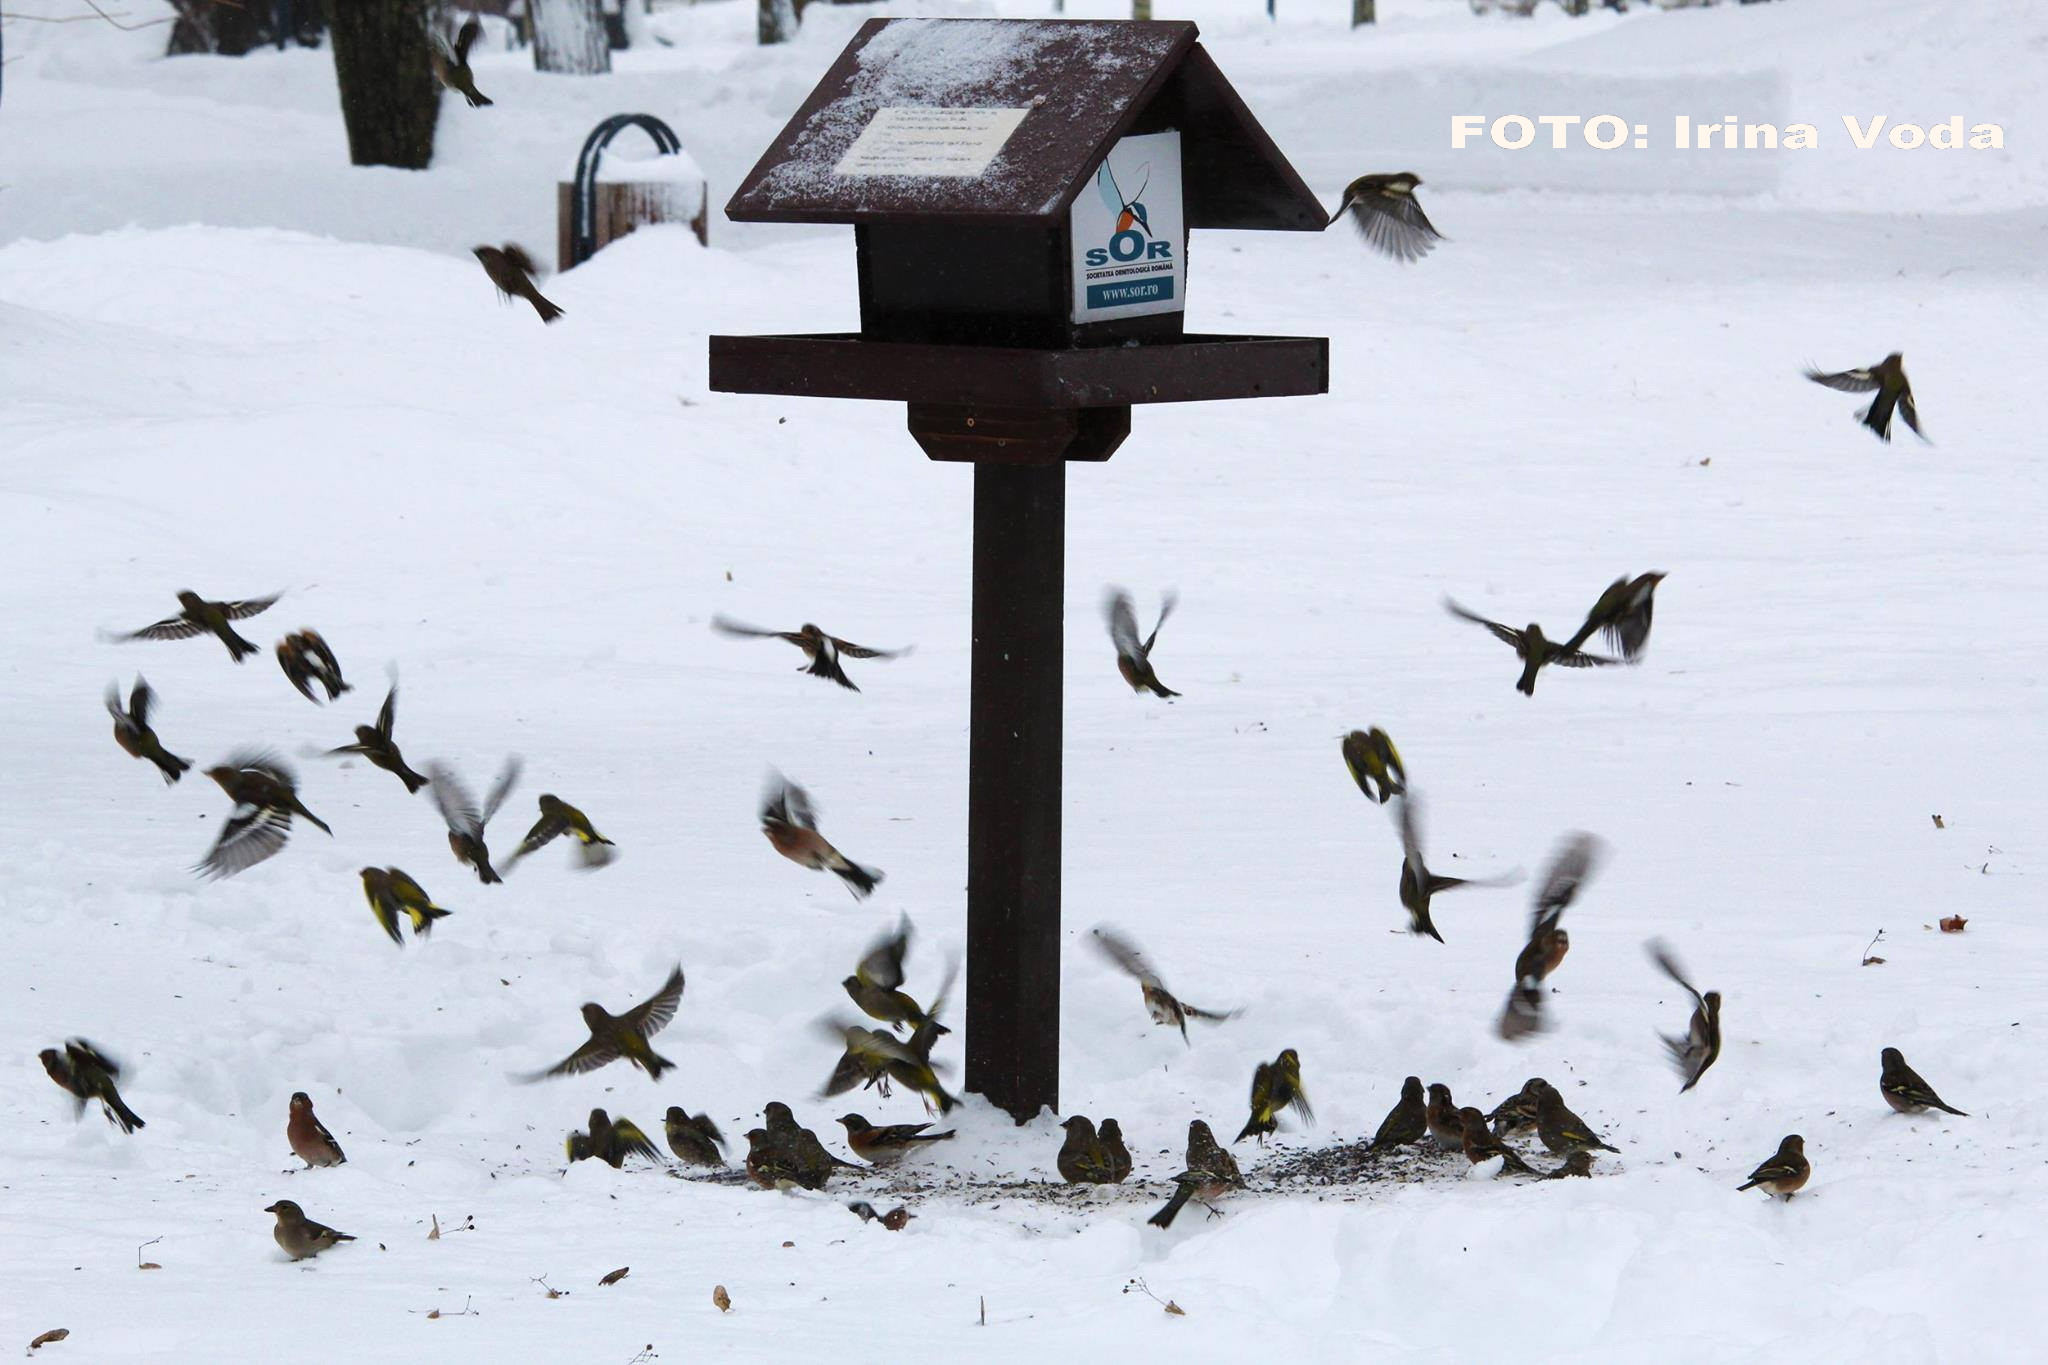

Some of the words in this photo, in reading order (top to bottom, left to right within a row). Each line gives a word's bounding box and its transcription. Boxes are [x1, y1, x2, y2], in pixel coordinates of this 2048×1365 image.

[1086, 230, 1172, 266] SOR
[1086, 270, 1114, 280] SOCIETATEA
[1103, 285, 1158, 300] www.sor.ro
